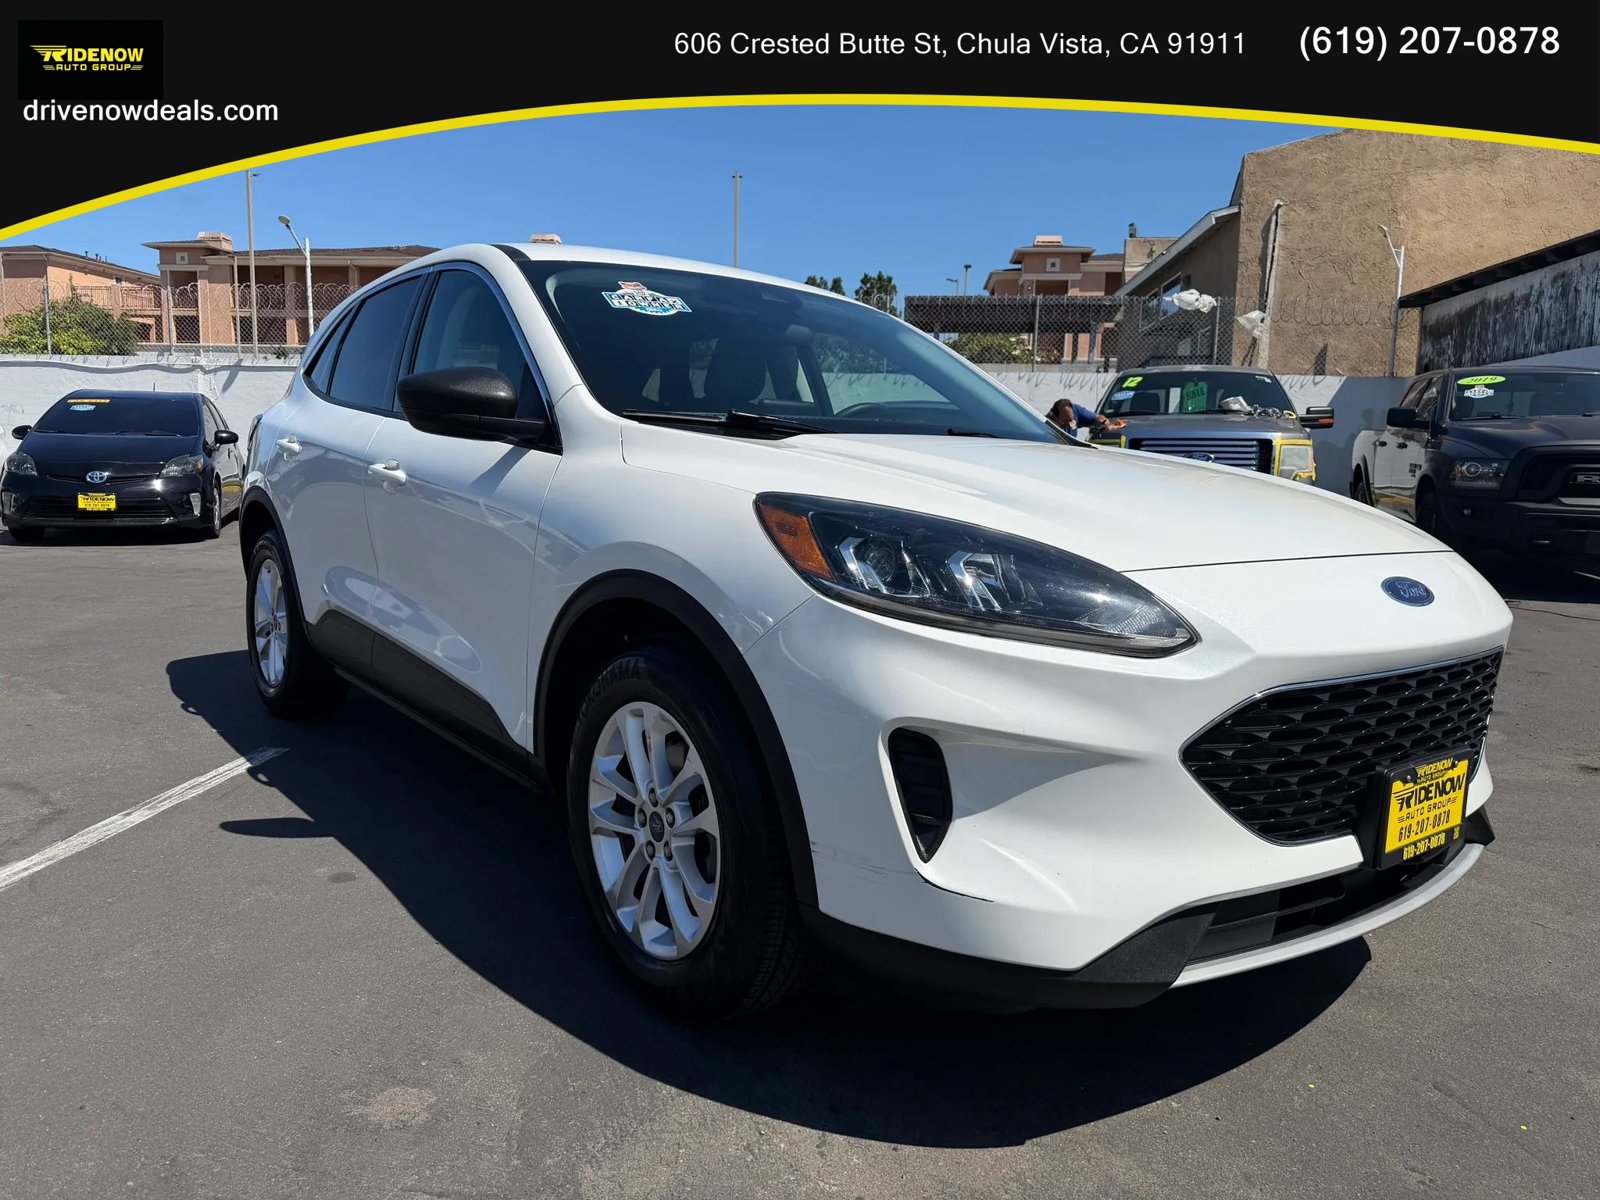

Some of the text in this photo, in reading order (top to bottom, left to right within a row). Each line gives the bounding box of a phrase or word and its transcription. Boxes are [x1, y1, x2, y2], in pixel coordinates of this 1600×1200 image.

[1392, 774, 1465, 811] RIDENOW
[1406, 798, 1450, 820] AUTO GROUP
[1399, 809, 1451, 842] 619-207-0878
